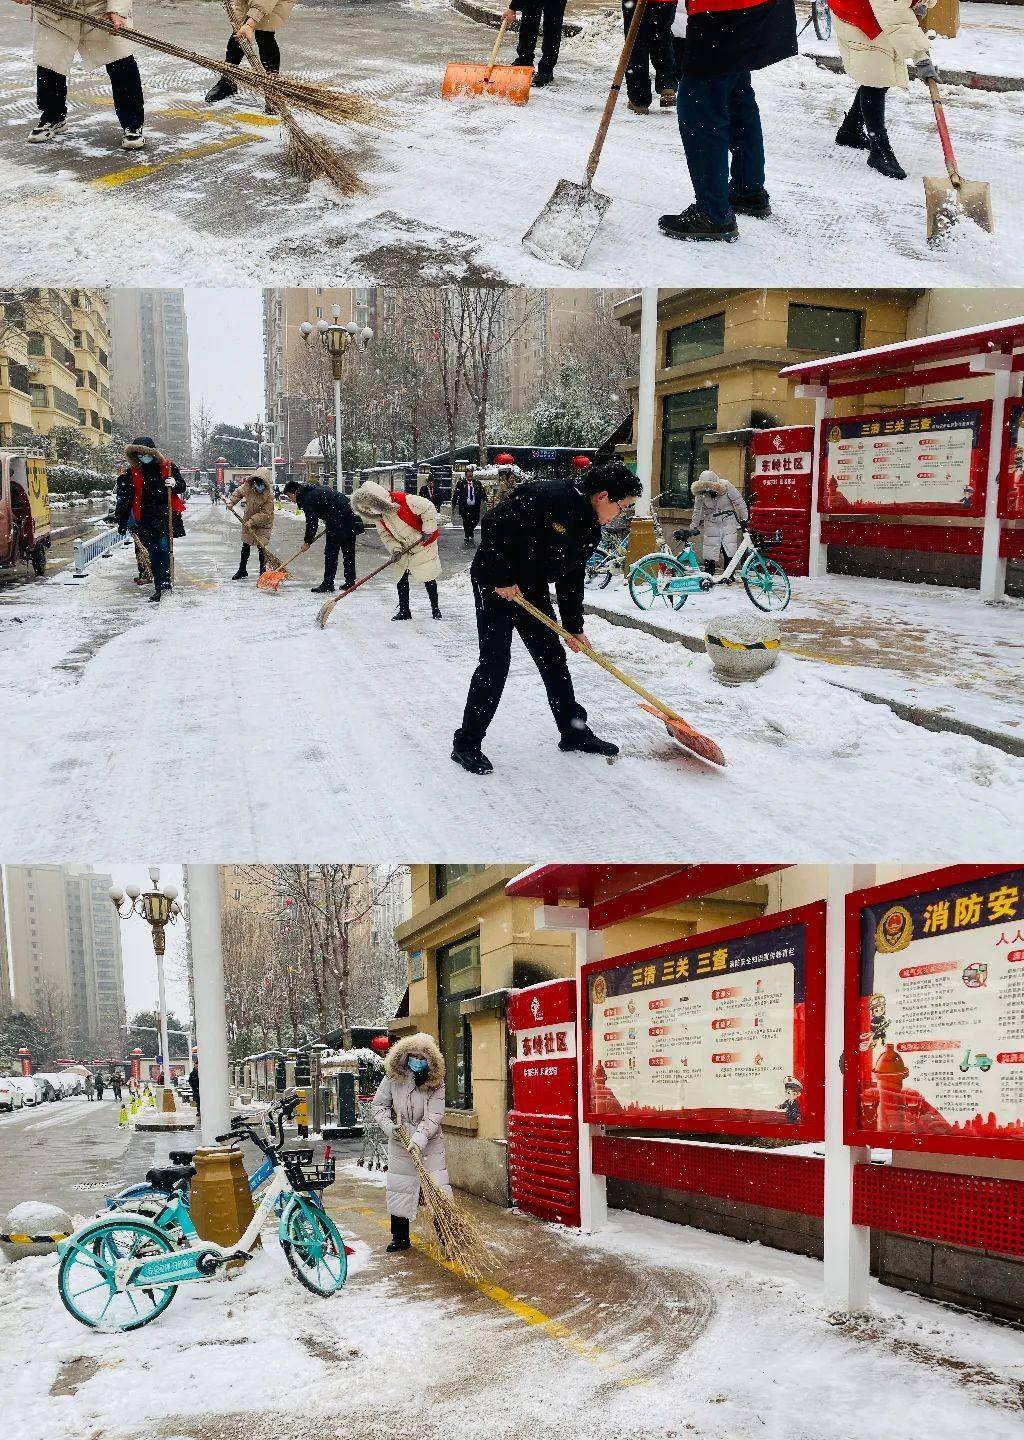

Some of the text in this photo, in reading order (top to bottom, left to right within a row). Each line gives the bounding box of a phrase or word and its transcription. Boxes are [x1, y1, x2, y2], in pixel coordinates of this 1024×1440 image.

[860, 423, 880, 436] 三清
[884, 419, 906, 433] 三关
[761, 457, 803, 472] 东岭社区
[923, 885, 1019, 933] 消防安
[631, 965, 656, 987] 三清
[662, 956, 690, 981] 三关
[696, 948, 729, 974] 三查
[522, 1031, 567, 1057] 东岭社区
